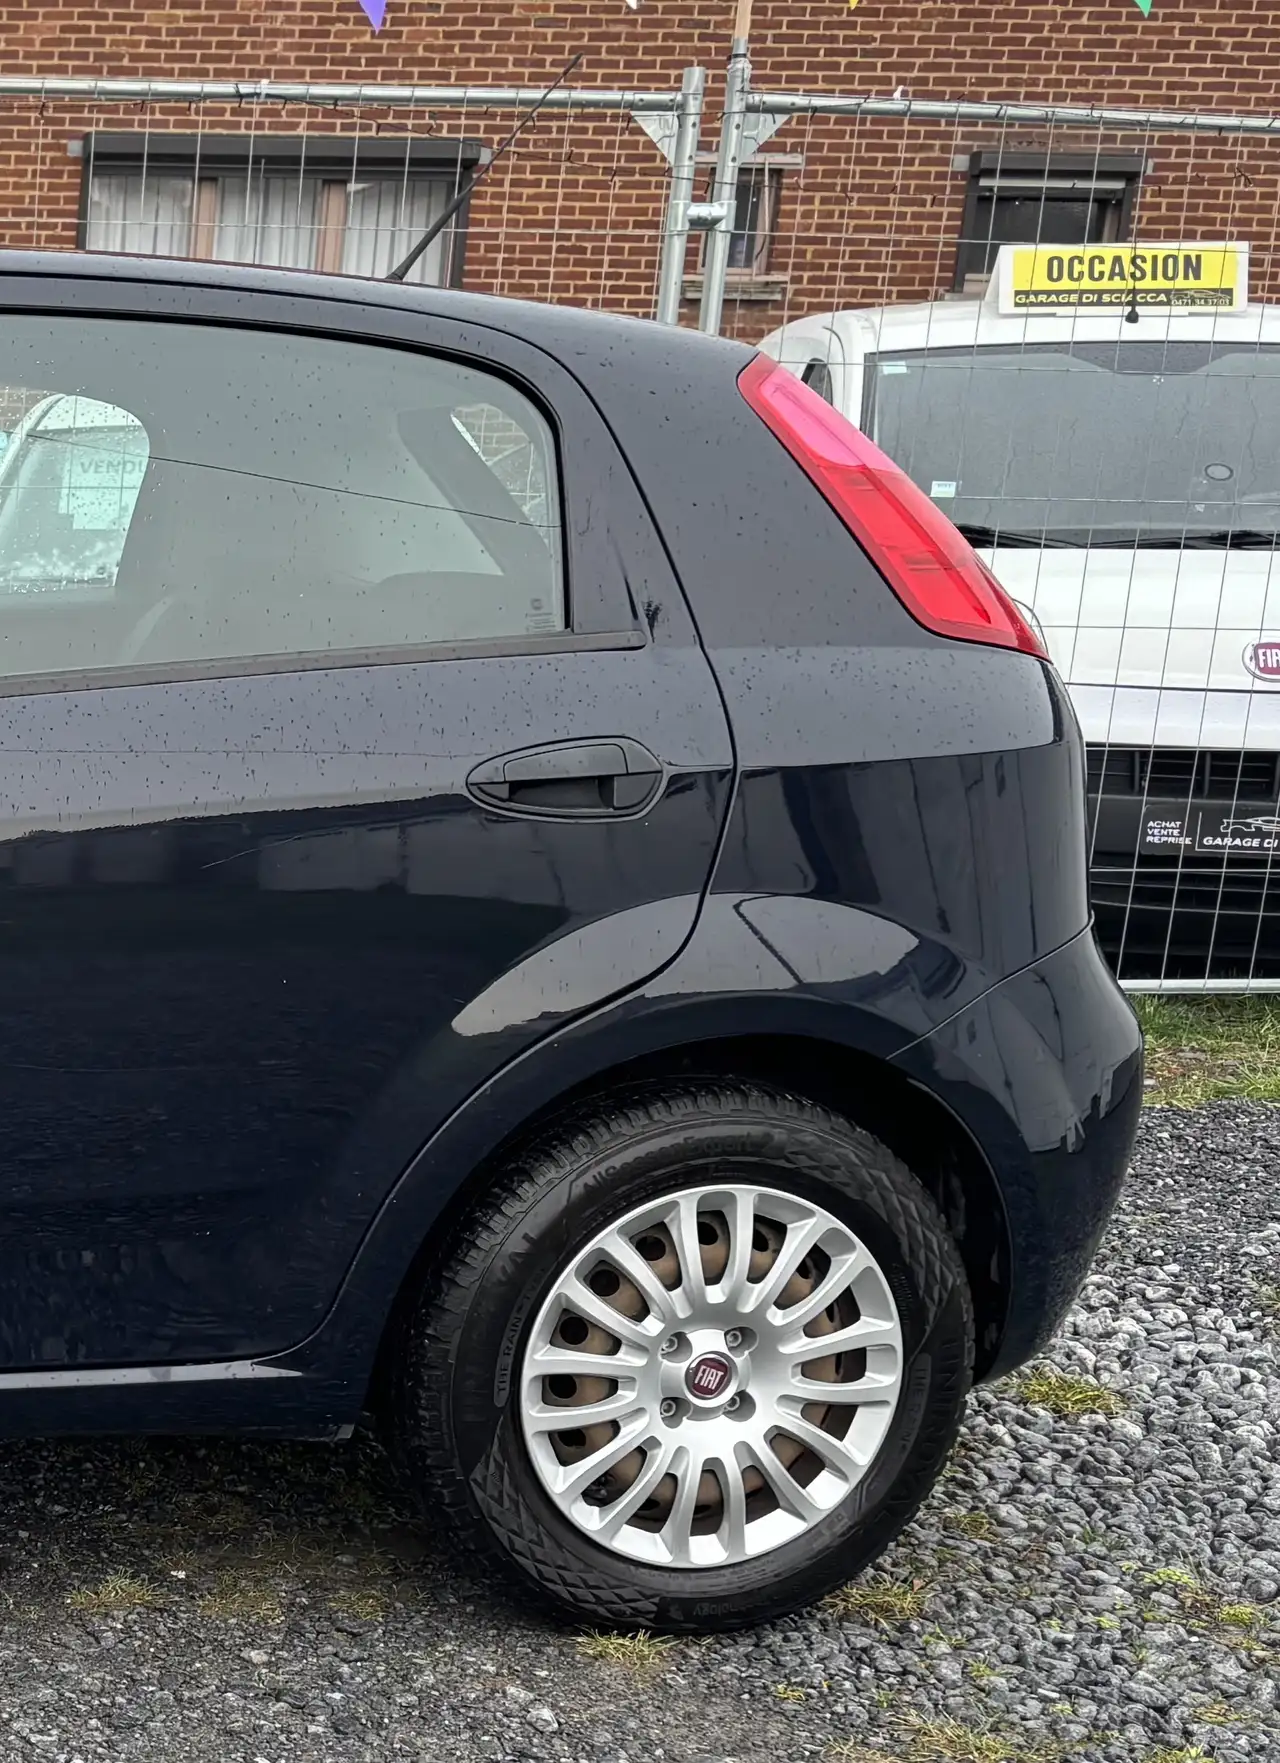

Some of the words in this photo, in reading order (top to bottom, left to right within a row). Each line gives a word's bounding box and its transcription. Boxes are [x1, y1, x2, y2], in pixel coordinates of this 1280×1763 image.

[1046, 254, 1202, 283] OCCASION
[1015, 293, 1079, 304] GARAGE
[1082, 293, 1097, 304] DI
[1147, 820, 1182, 828] ACHAT
[1147, 828, 1181, 836] VENTE
[1146, 836, 1192, 845] REPRISE
[1203, 836, 1261, 847] GARAGE
[694, 1364, 725, 1390] FIAT
